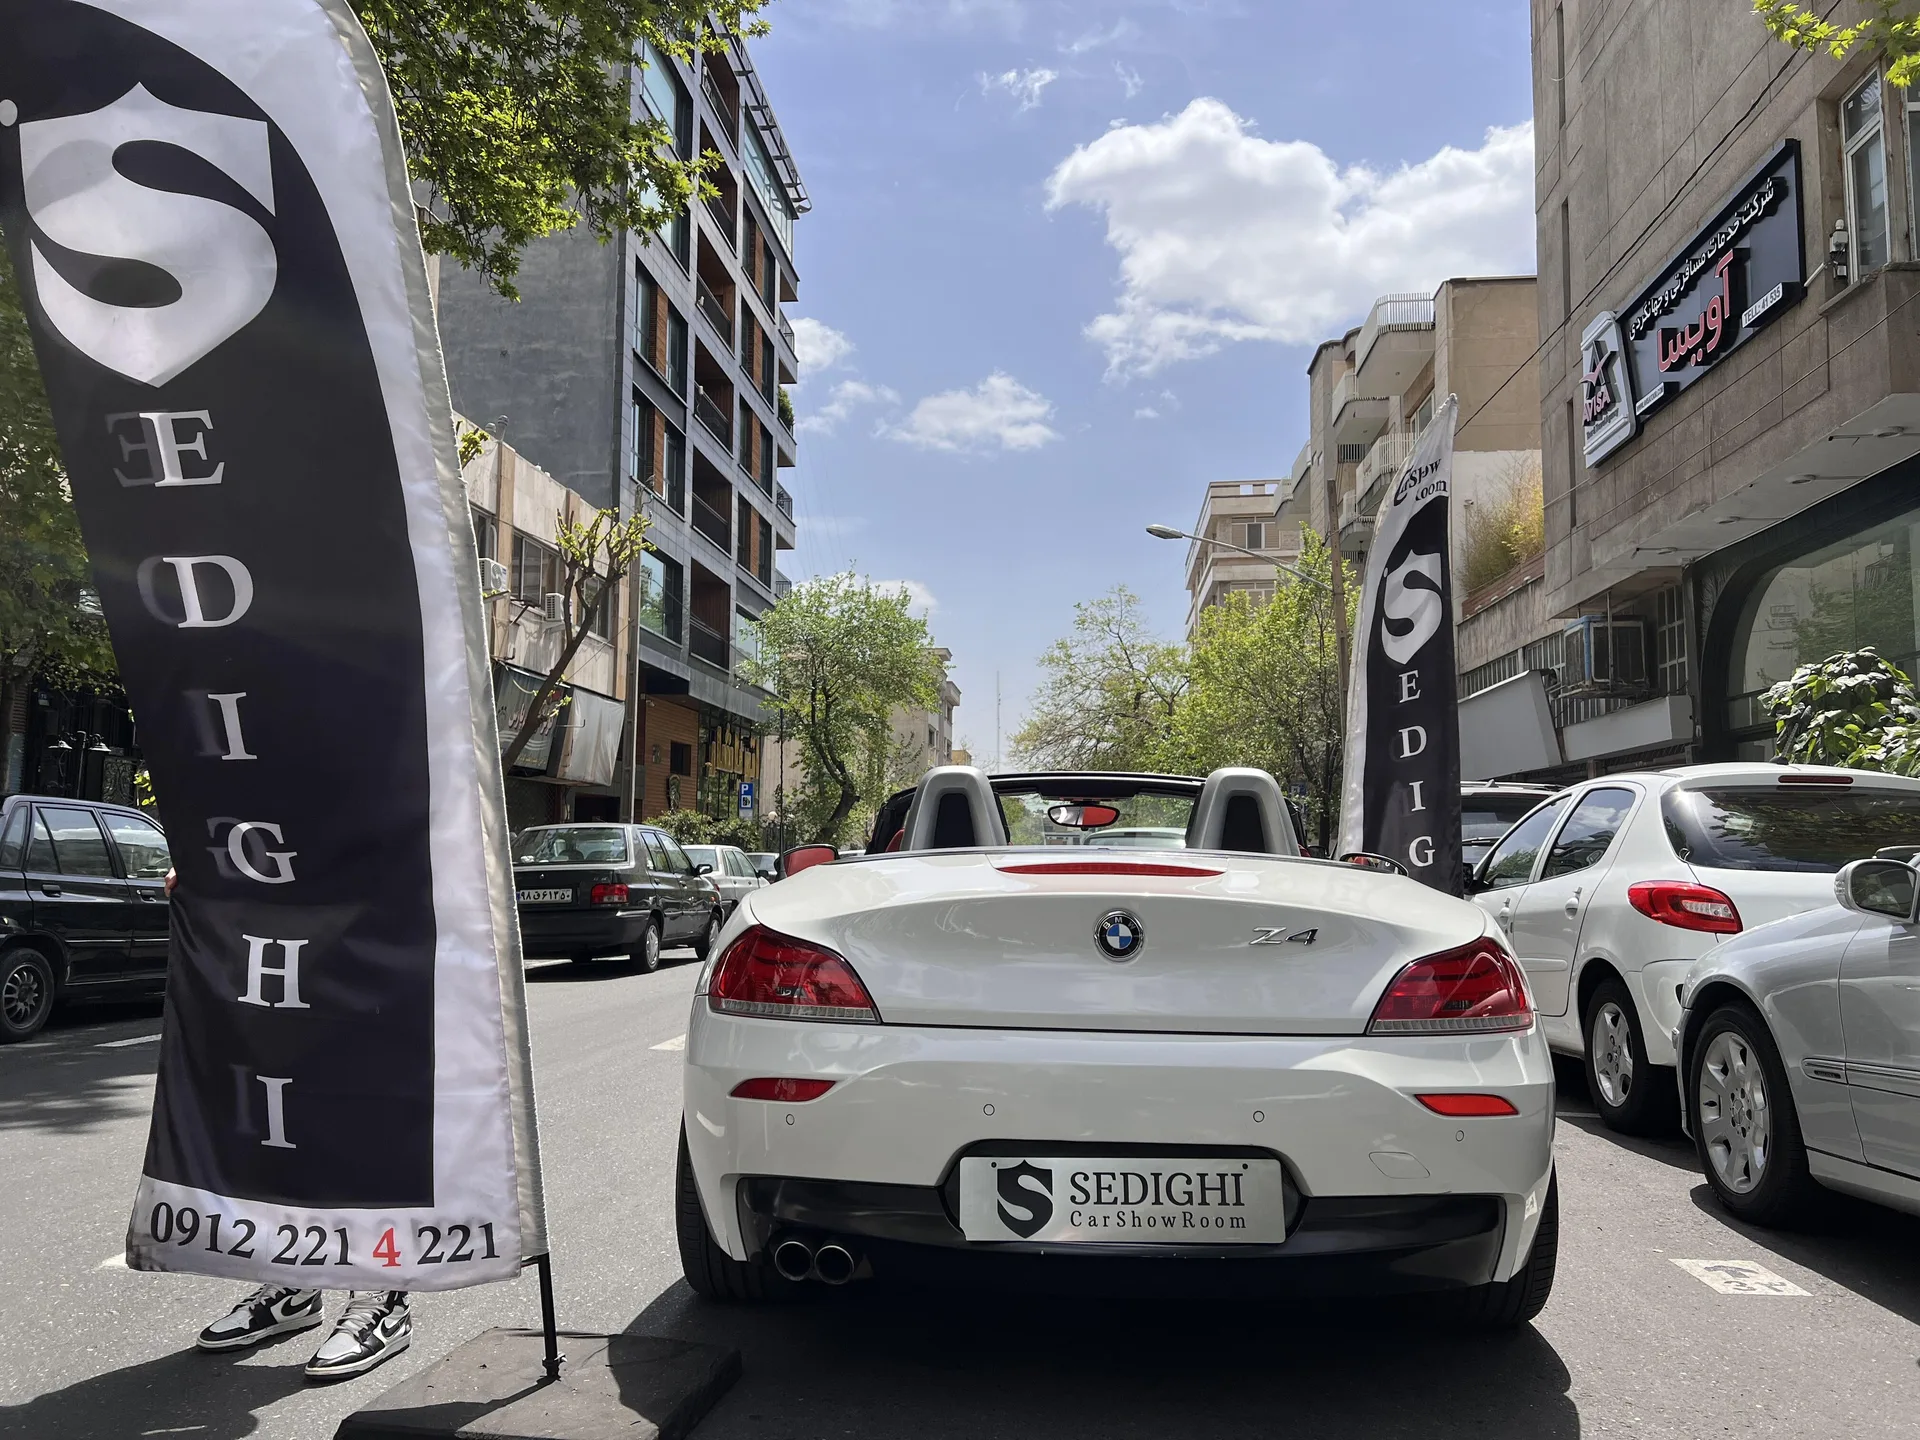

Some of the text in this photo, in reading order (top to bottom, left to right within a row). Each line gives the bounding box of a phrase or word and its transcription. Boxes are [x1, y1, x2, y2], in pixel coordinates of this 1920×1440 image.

[1742, 177, 1774, 225] شرکت
[1705, 212, 1740, 259] خدمات
[1670, 254, 1706, 298] مسافرتی
[1657, 249, 1734, 373] آویسا
[1664, 290, 1669, 304] و
[1582, 385, 1611, 423] AVISA
[741, 784, 749, 795] P
[1249, 926, 1318, 945] Z4
[1070, 1172, 1245, 1207] SEDIGHI
[151, 1202, 500, 1267] 0912 221 4 221
